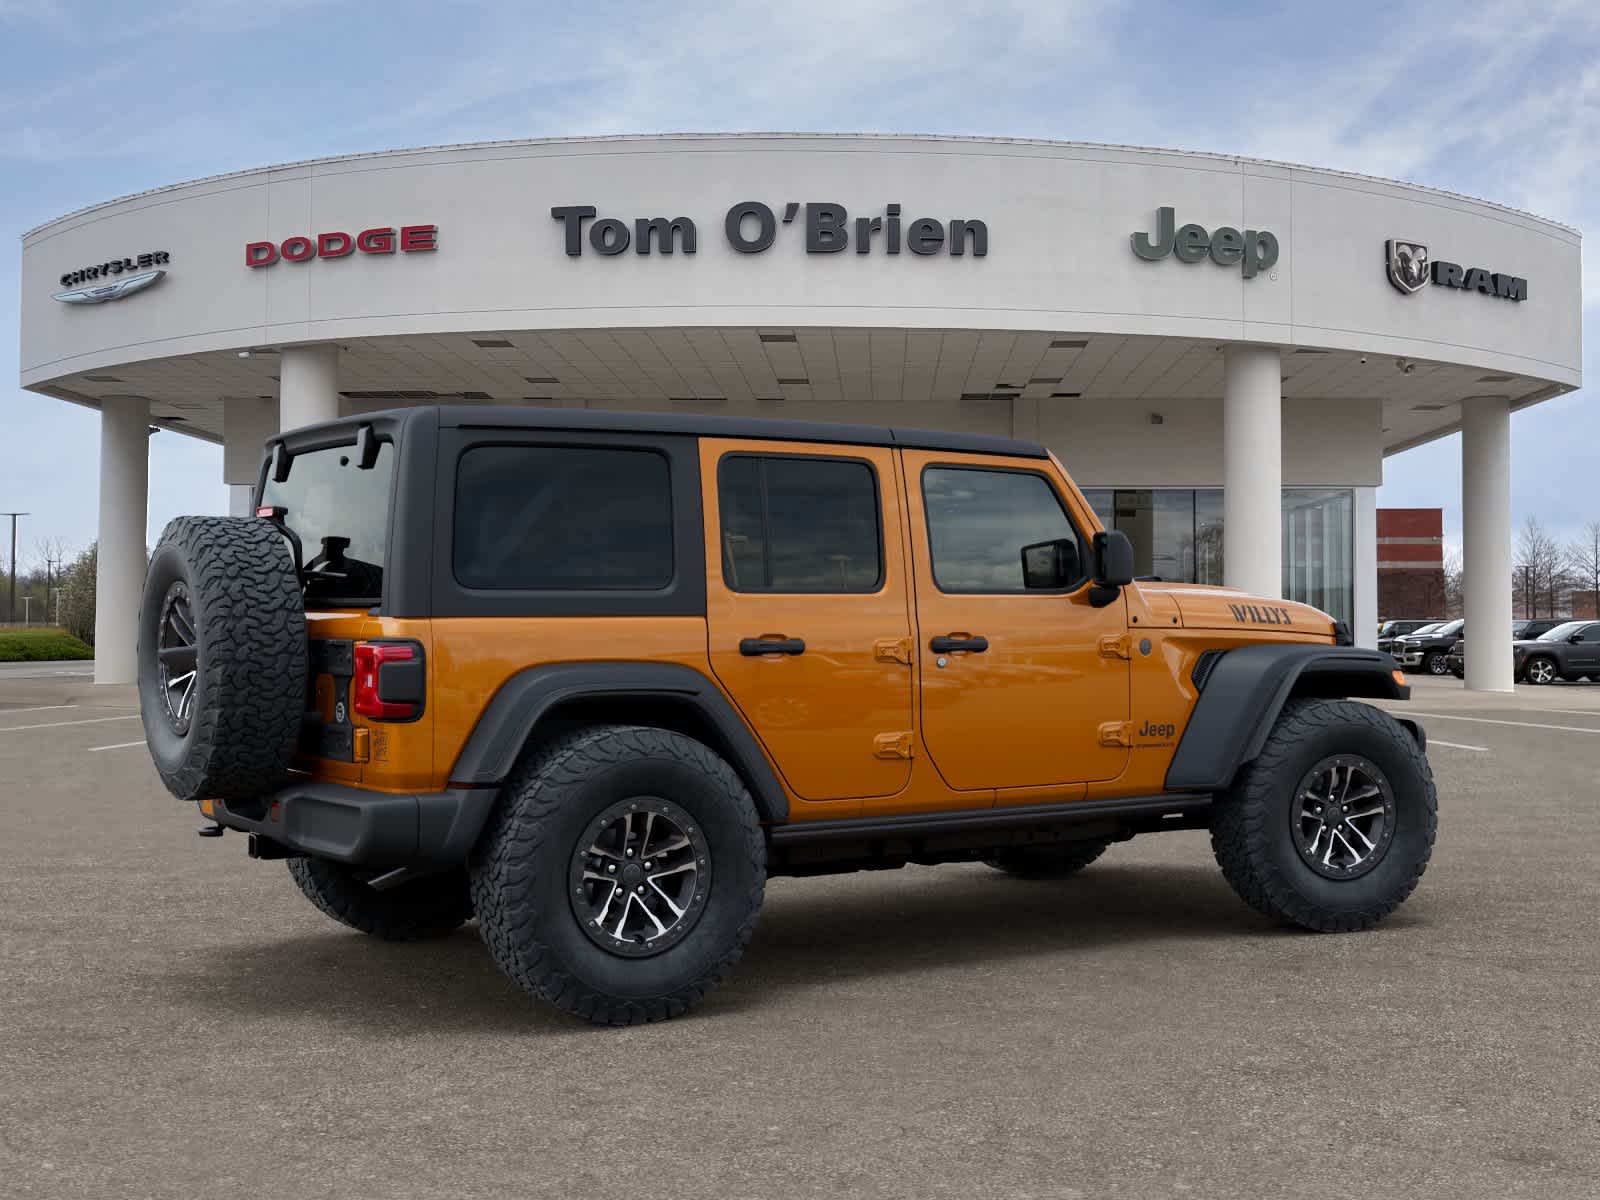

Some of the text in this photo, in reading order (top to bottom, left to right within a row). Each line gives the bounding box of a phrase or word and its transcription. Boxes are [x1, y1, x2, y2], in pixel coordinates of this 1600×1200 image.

[245, 224, 439, 269] DODGE
[551, 201, 988, 257] Tom O'Brien
[1130, 206, 1280, 280] Jeep
[60, 250, 170, 287] CHRYSLER
[1430, 261, 1528, 301] RAM
[1139, 720, 1176, 741] Jeep
